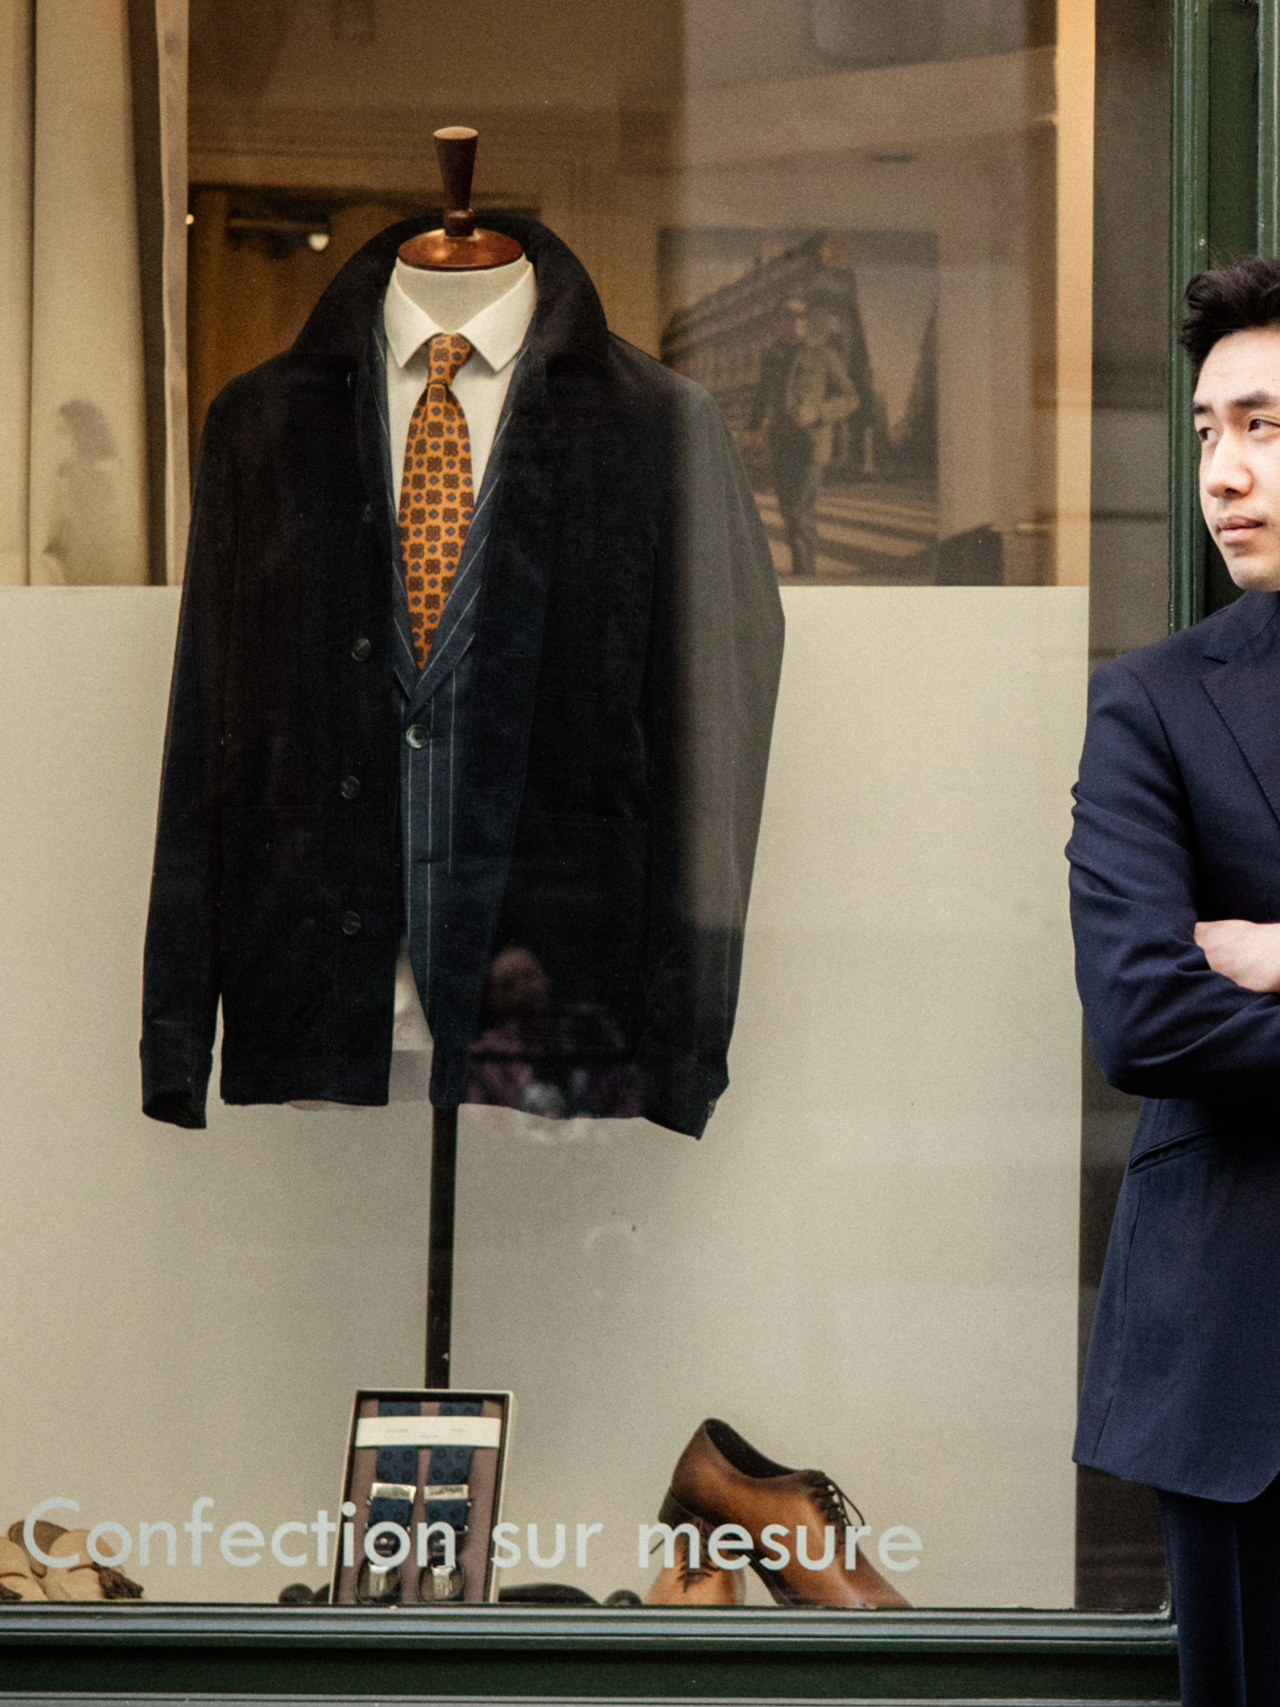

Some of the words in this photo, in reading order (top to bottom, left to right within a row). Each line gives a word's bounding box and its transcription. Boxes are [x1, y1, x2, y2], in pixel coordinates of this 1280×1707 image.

[23, 1497, 456, 1569] Confection
[490, 1522, 603, 1569] sur
[638, 1524, 923, 1572] mesure
